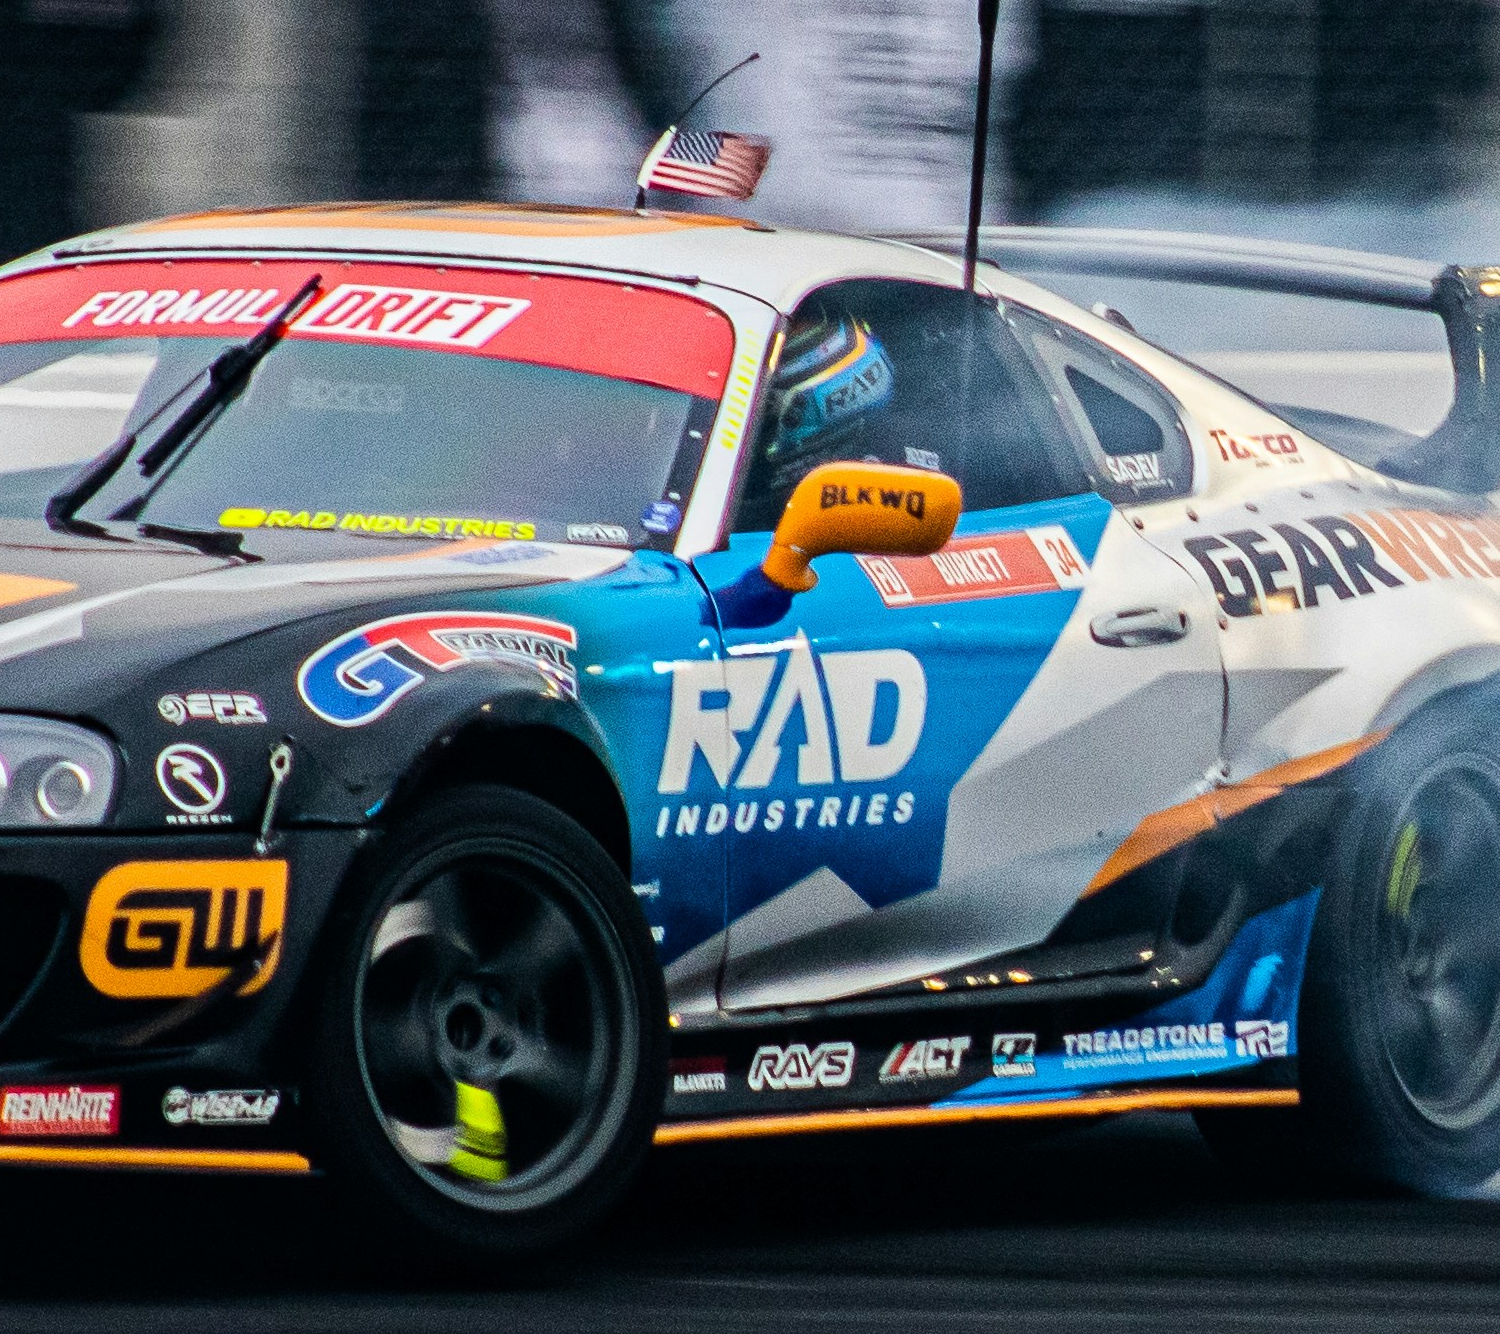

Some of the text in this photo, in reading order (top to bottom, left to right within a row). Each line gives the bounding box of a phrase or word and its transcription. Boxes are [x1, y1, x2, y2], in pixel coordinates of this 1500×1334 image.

[306, 287, 512, 340] DRIFT
[1106, 453, 1159, 483] SADEV
[266, 509, 536, 540] RAD INDUSTRIES
[929, 547, 1011, 586] BURKETT
[1043, 538, 1084, 577] 34
[657, 627, 927, 794] RAD
[656, 792, 915, 838] INDUSTRIES
[1063, 1022, 1226, 1057] TREADSTONE
[749, 1042, 855, 1091] RAYS
